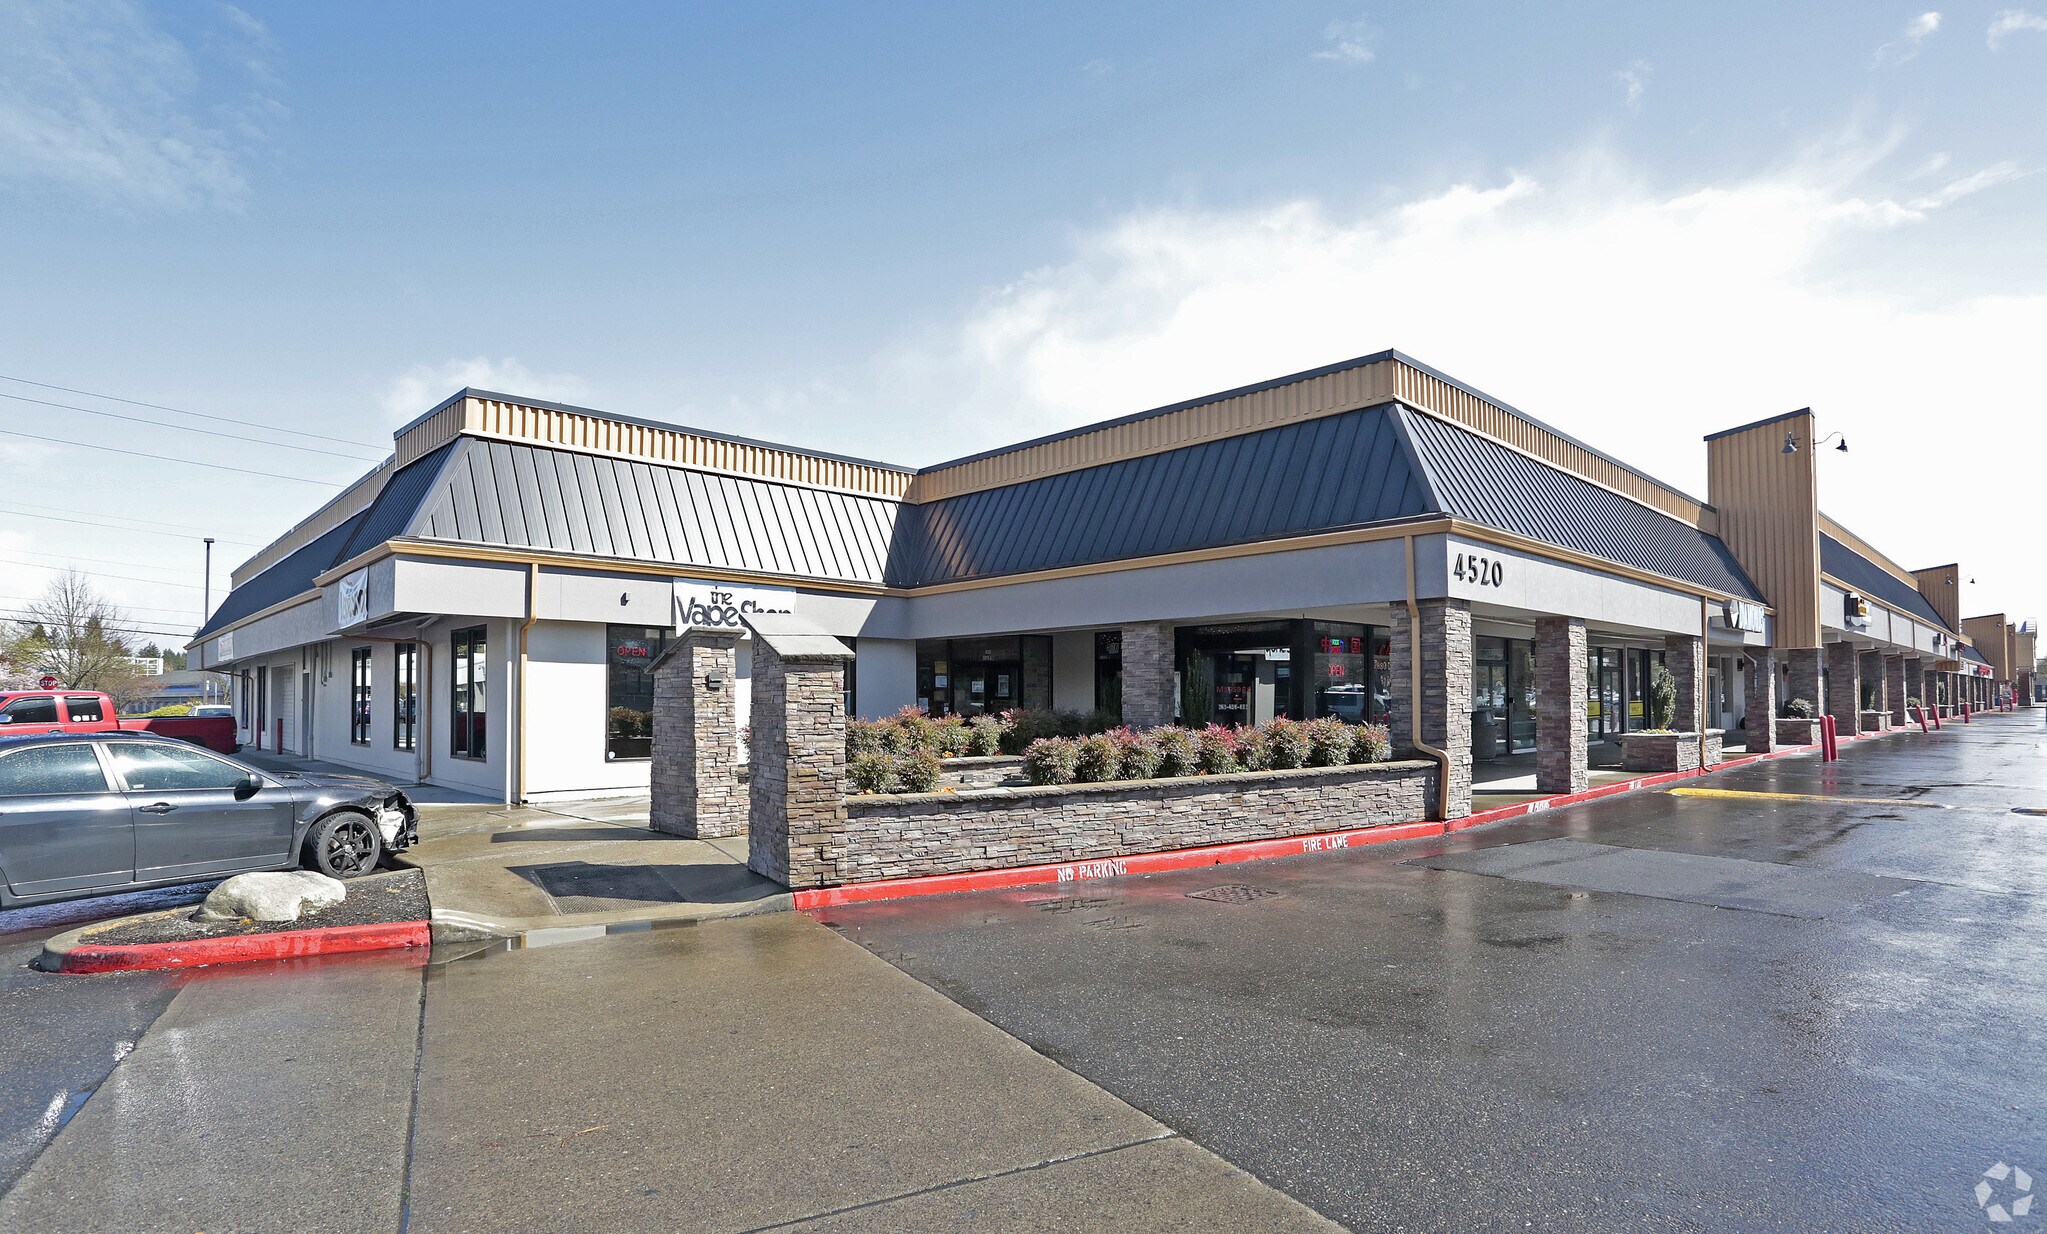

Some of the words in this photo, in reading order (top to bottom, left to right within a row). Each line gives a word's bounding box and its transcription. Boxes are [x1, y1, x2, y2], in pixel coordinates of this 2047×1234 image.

[1453, 553, 1504, 588] 4520
[676, 595, 739, 627] Vape
[617, 645, 647, 657] OPEN
[1302, 839, 1323, 853] FIRE
[1325, 835, 1349, 850] LANE
[1057, 867, 1075, 882] NO
[1079, 860, 1128, 879] PARKING
